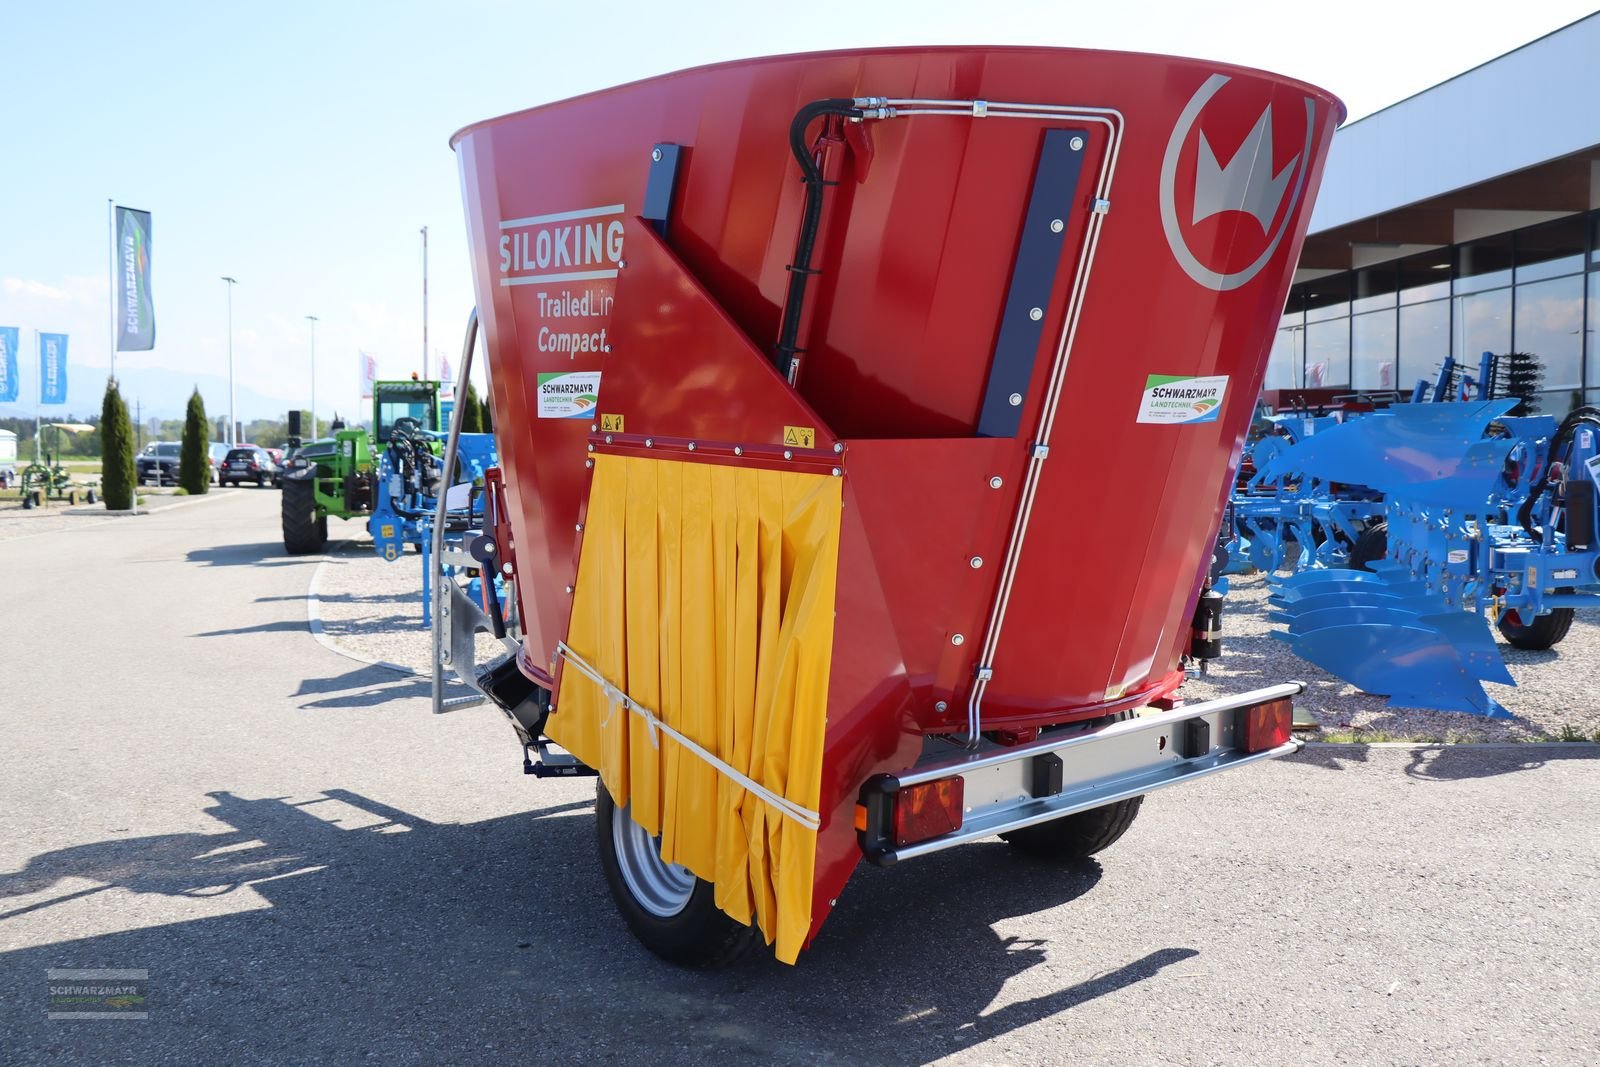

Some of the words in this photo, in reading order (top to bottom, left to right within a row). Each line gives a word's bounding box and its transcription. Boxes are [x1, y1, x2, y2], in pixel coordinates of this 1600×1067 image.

[499, 220, 625, 272] SILOKING
[125, 236, 138, 334] SCHWARZMAYR
[537, 288, 614, 318] TrailedLin
[538, 326, 606, 360] Compact
[542, 383, 593, 394] SCHWARZMAYR
[1152, 387, 1217, 399] SCHWARZMAYR
[1150, 400, 1192, 409] LANDTECHNIK
